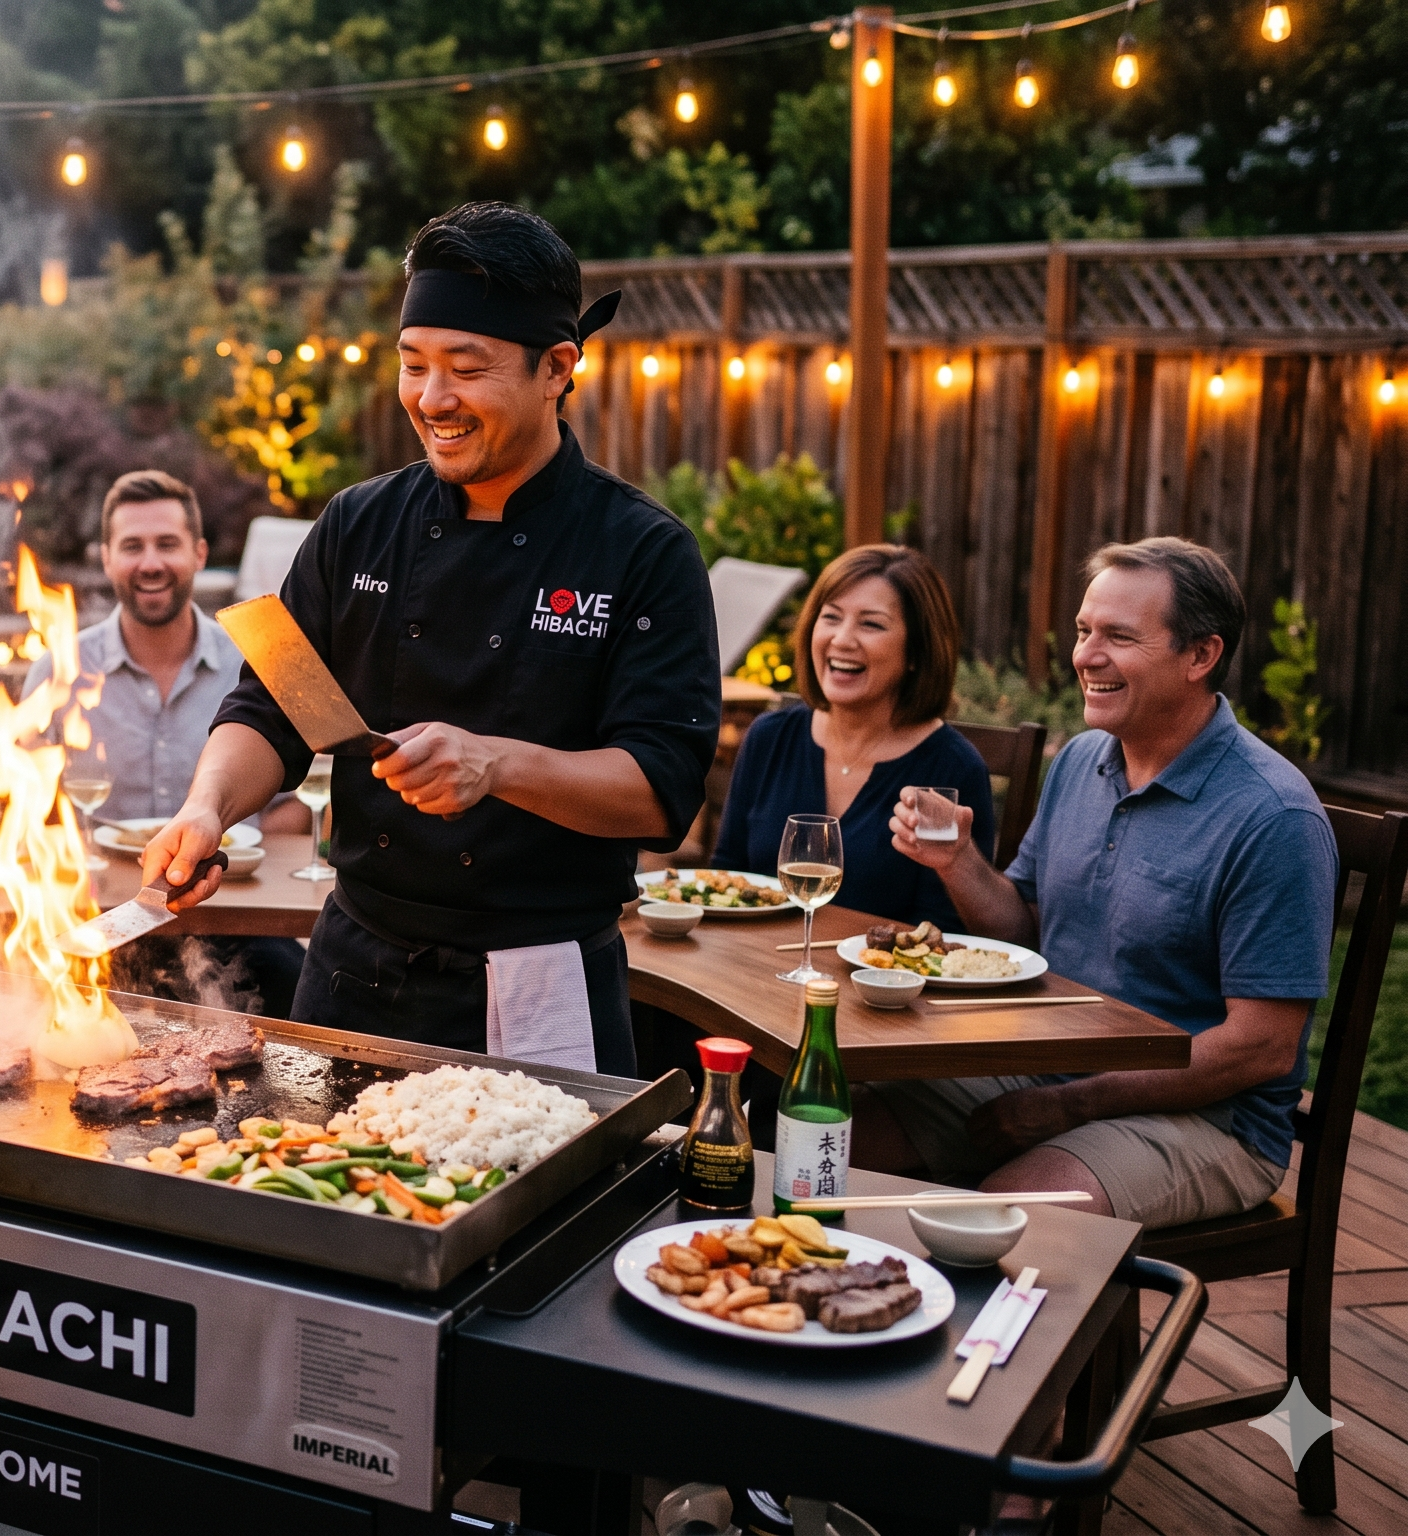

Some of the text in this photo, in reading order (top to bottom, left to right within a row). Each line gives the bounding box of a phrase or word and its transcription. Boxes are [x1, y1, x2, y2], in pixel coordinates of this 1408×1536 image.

[351, 572, 389, 594] Hiro
[530, 613, 608, 639] HIBACHI
[292, 1433, 395, 1477] IMPERIAL
